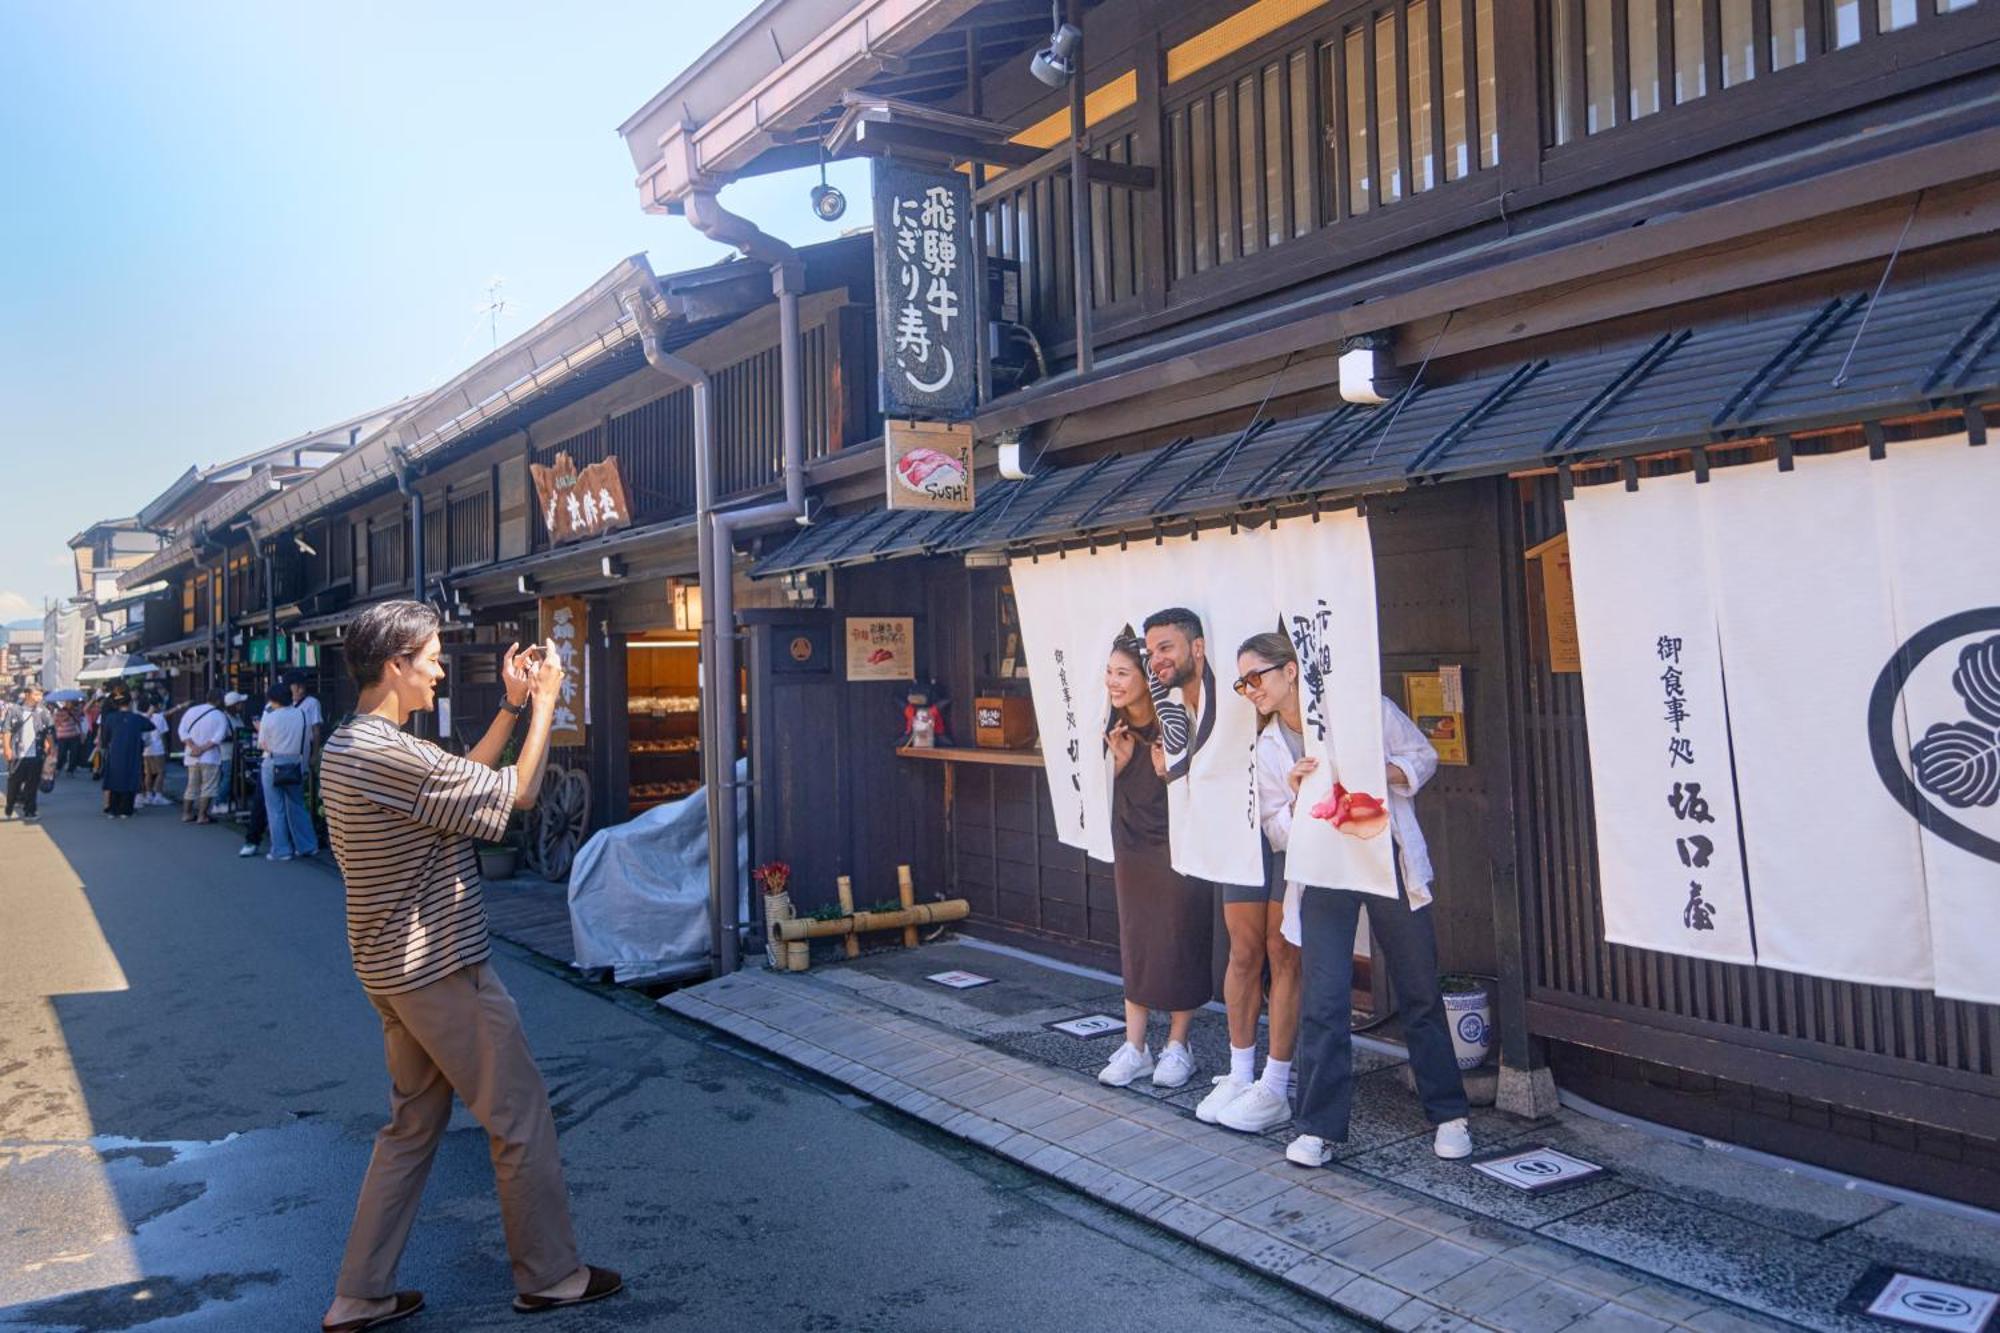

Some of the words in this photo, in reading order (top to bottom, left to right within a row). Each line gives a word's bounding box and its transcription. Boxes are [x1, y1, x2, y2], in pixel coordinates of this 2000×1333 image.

[892, 195, 954, 393] にぎり寿し
[920, 185, 958, 332] 飛騨牛
[1655, 634, 1695, 769] 御食事処
[1667, 781, 1716, 931] 坂口屋
